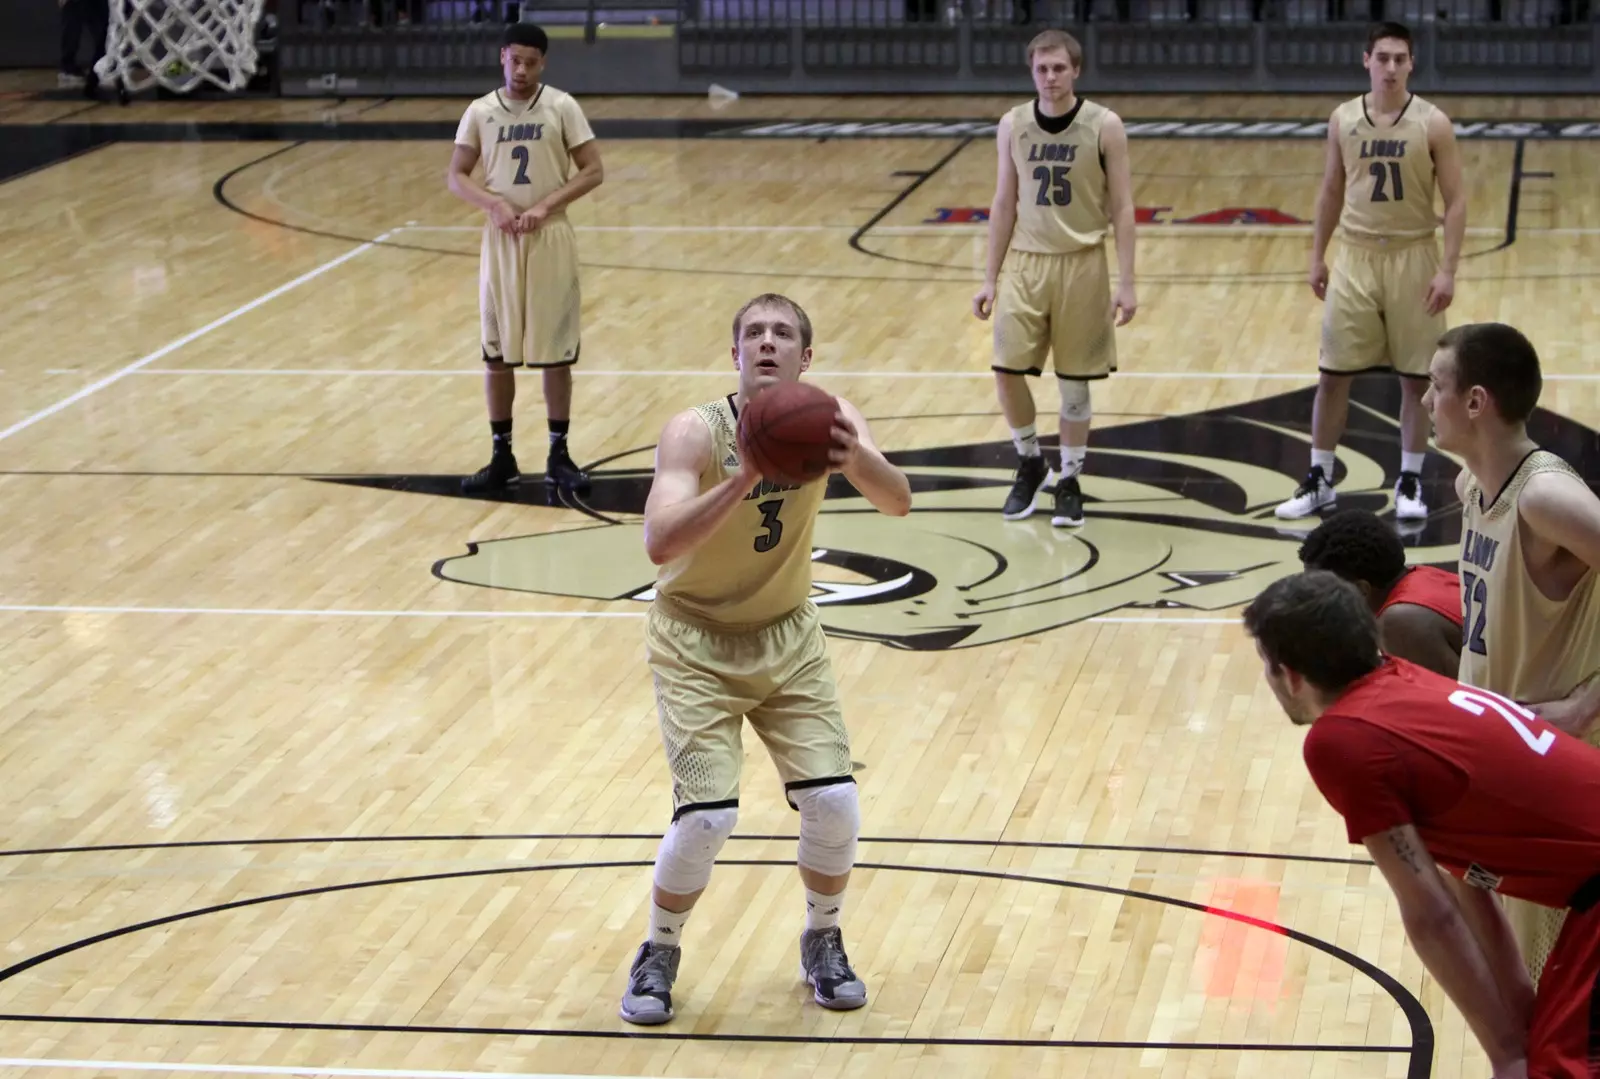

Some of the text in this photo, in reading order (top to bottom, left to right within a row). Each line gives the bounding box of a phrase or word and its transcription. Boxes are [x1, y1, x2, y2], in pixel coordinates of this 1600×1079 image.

[496, 123, 545, 144] LIONS
[1027, 143, 1079, 162] LIONS
[1359, 139, 1407, 159] LIONS
[511, 145, 532, 185] 2
[1369, 161, 1404, 203] 21
[1032, 166, 1072, 206] 25
[753, 498, 784, 553] 3
[1462, 528, 1500, 573] LIONS
